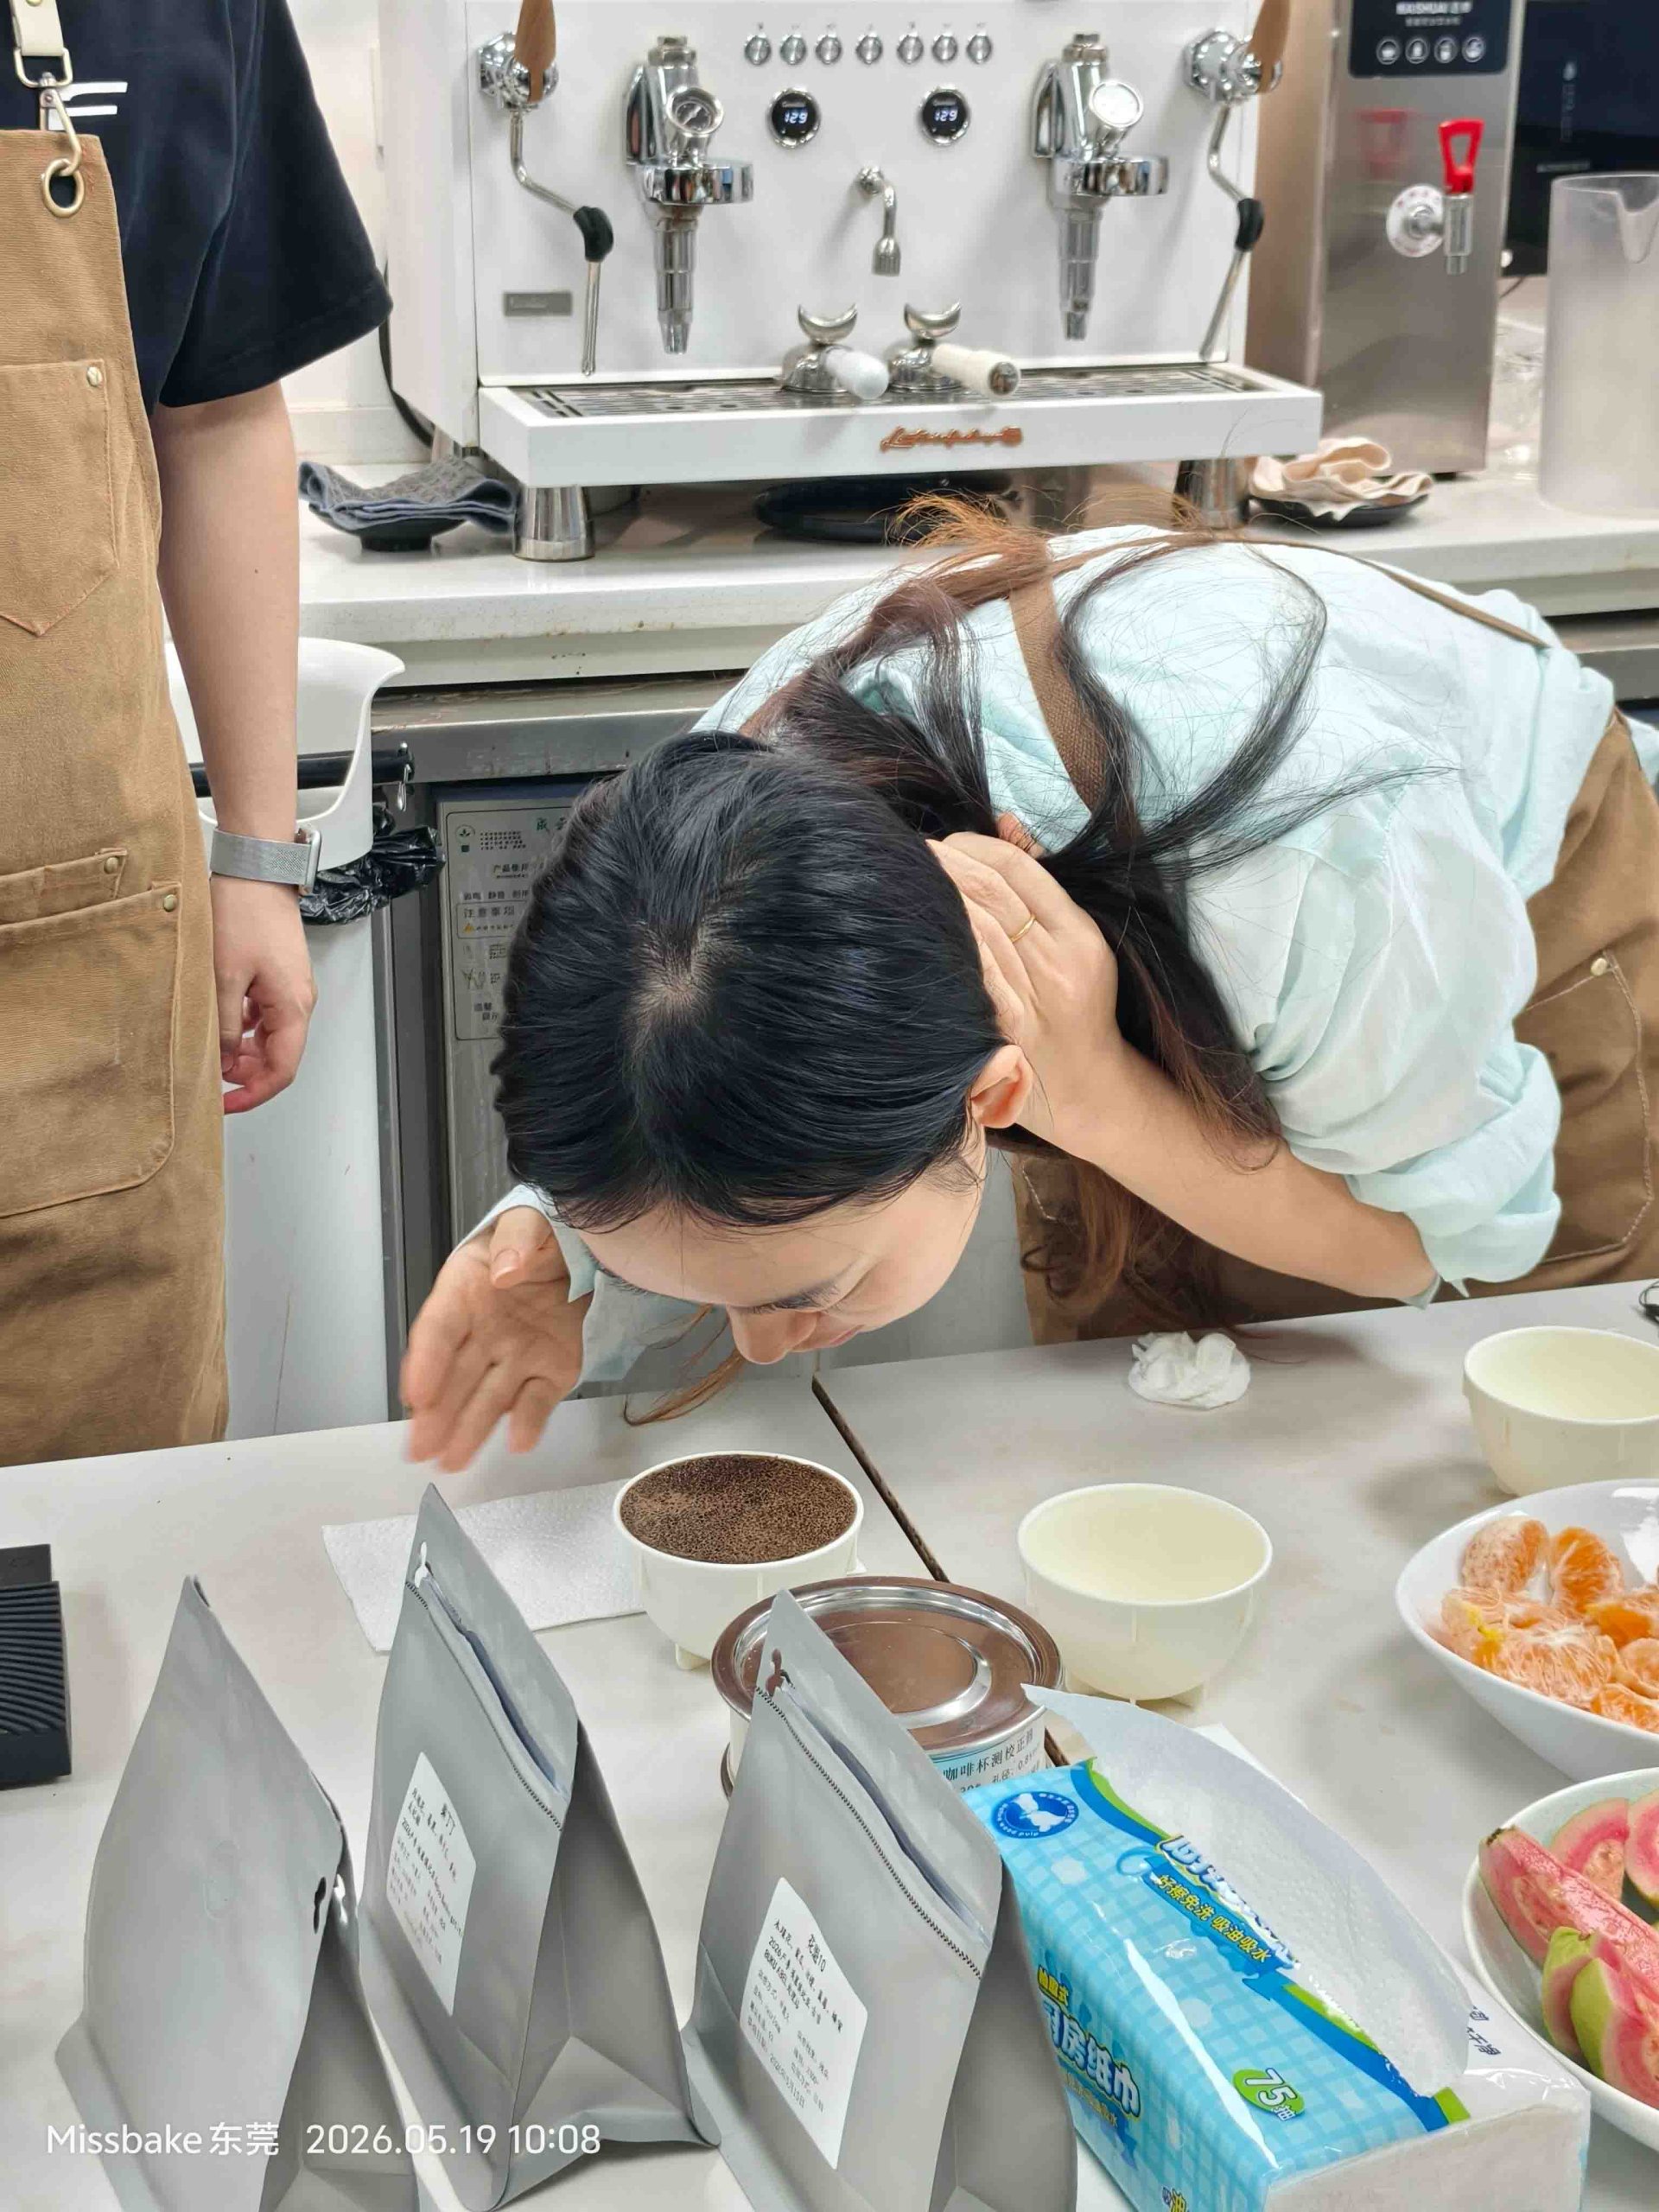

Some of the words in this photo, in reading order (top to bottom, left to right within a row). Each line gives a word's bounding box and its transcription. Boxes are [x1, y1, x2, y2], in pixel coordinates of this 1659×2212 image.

[785, 111, 808, 124] 129
[934, 109, 958, 122] 129
[1159, 1874, 1215, 1921] 好擦免洗
[1211, 1916, 1272, 1962] 吸油吸水
